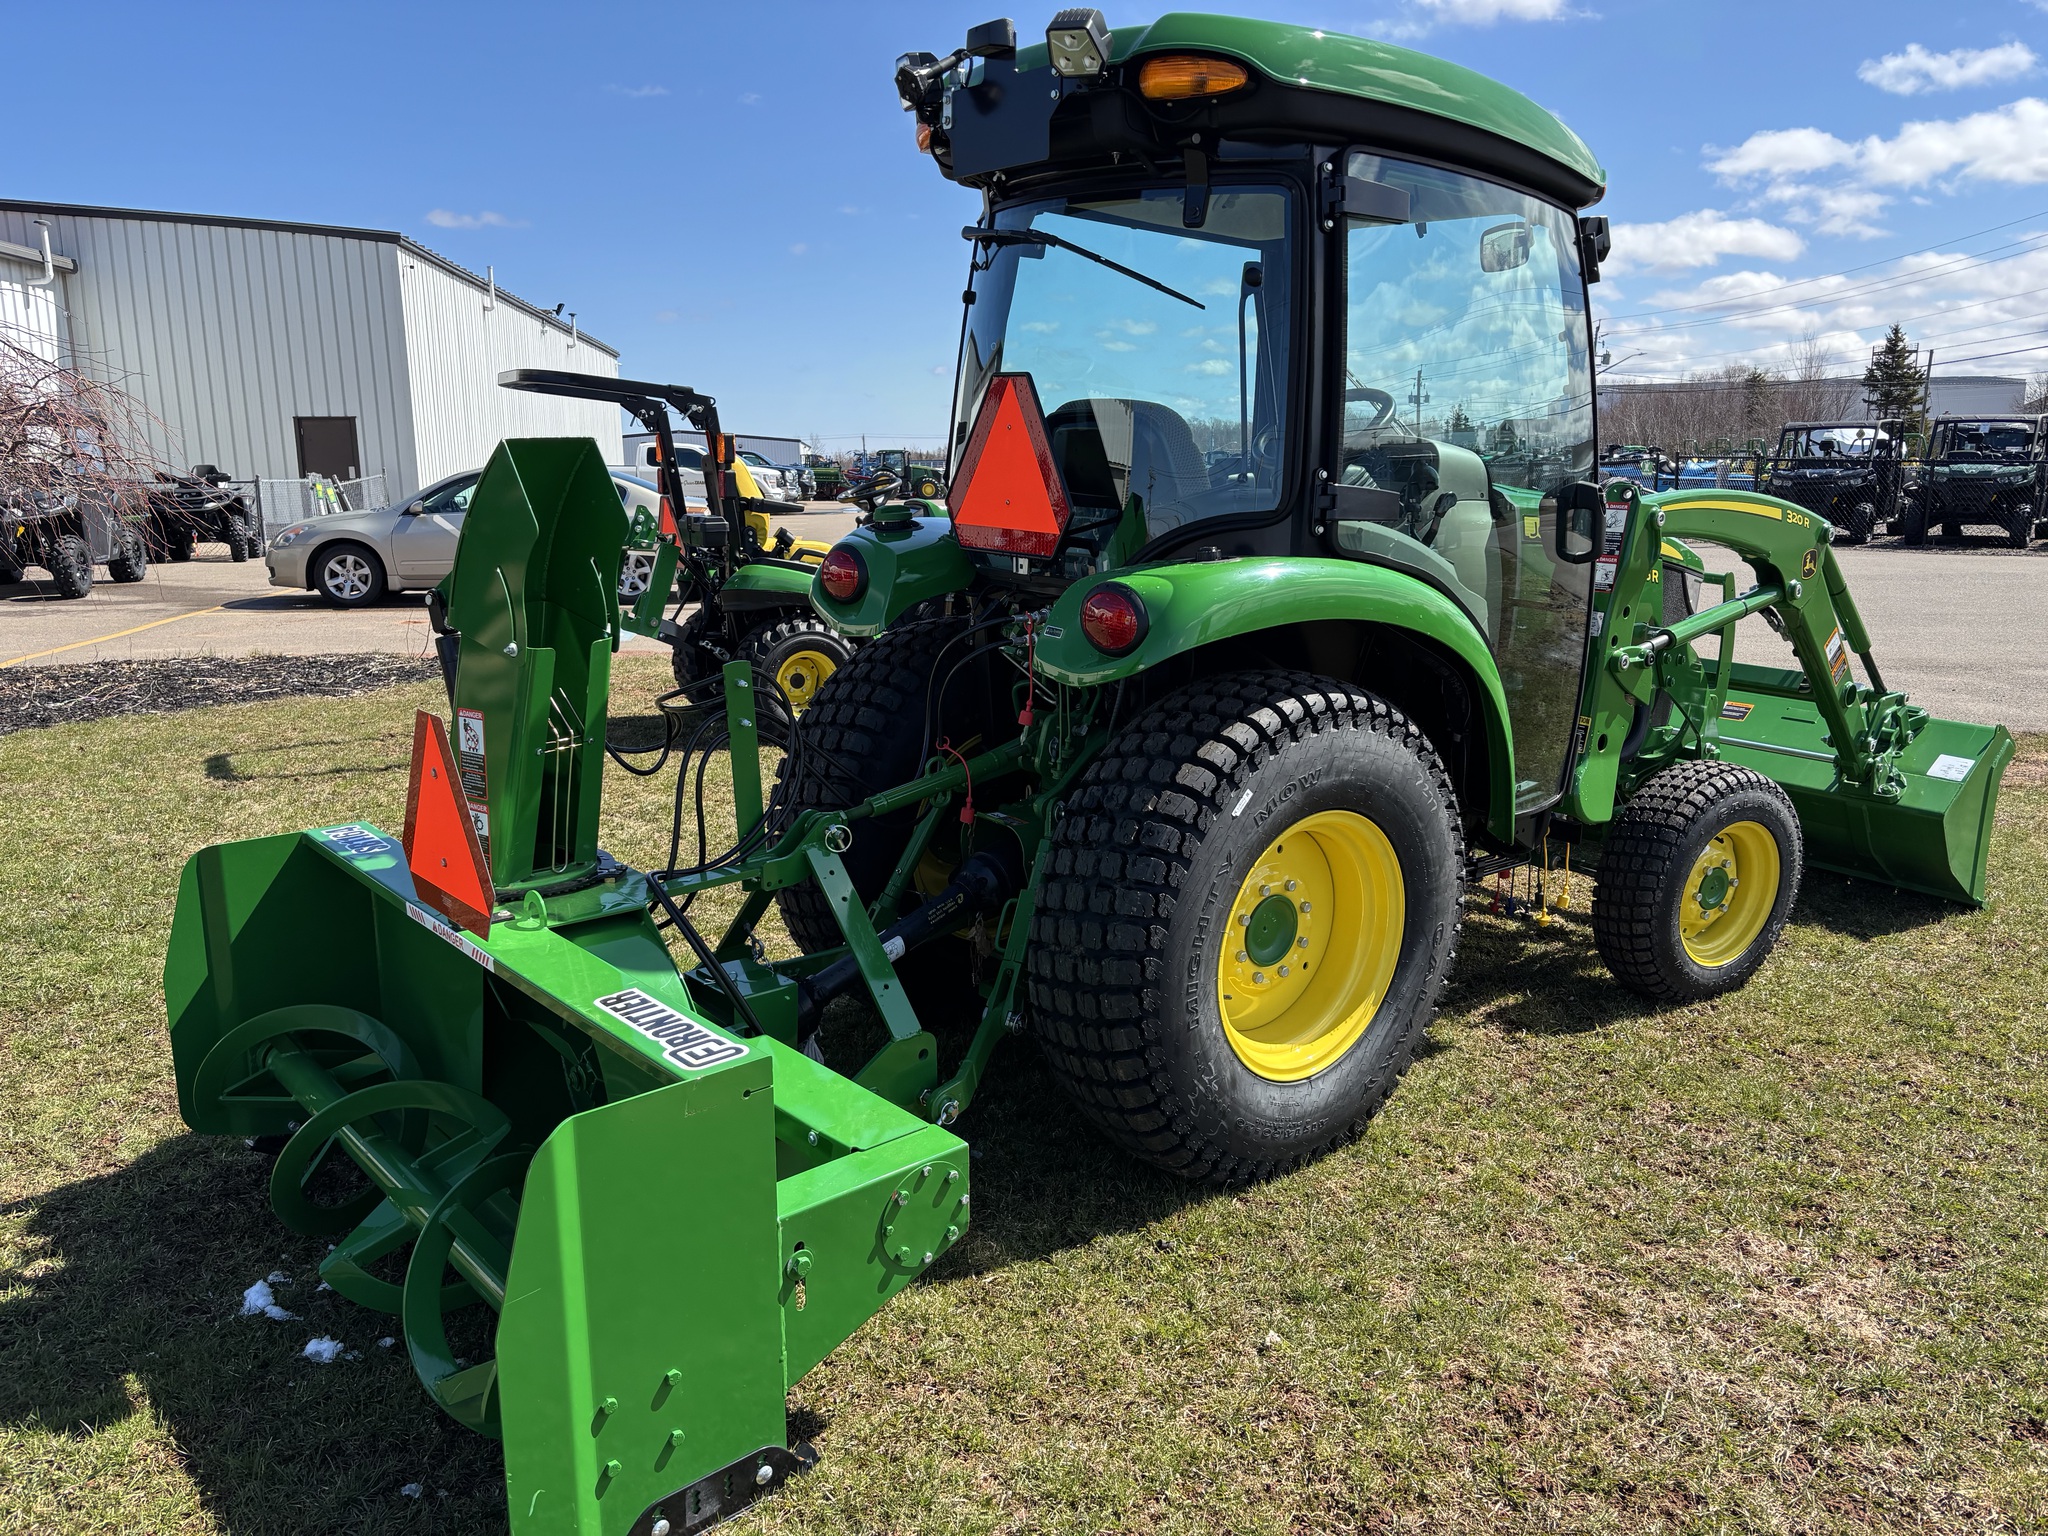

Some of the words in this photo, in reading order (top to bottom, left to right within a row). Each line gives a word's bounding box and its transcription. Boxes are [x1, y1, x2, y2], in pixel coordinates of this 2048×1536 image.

[1786, 509, 1803, 526] 320
[1804, 517, 1810, 529] R
[463, 710, 483, 720] DANGER
[1186, 849, 1234, 1032] MIGHTY
[1253, 766, 1323, 829] MOW
[437, 923, 465, 951] DANGER
[599, 990, 745, 1068] FRONTIER
